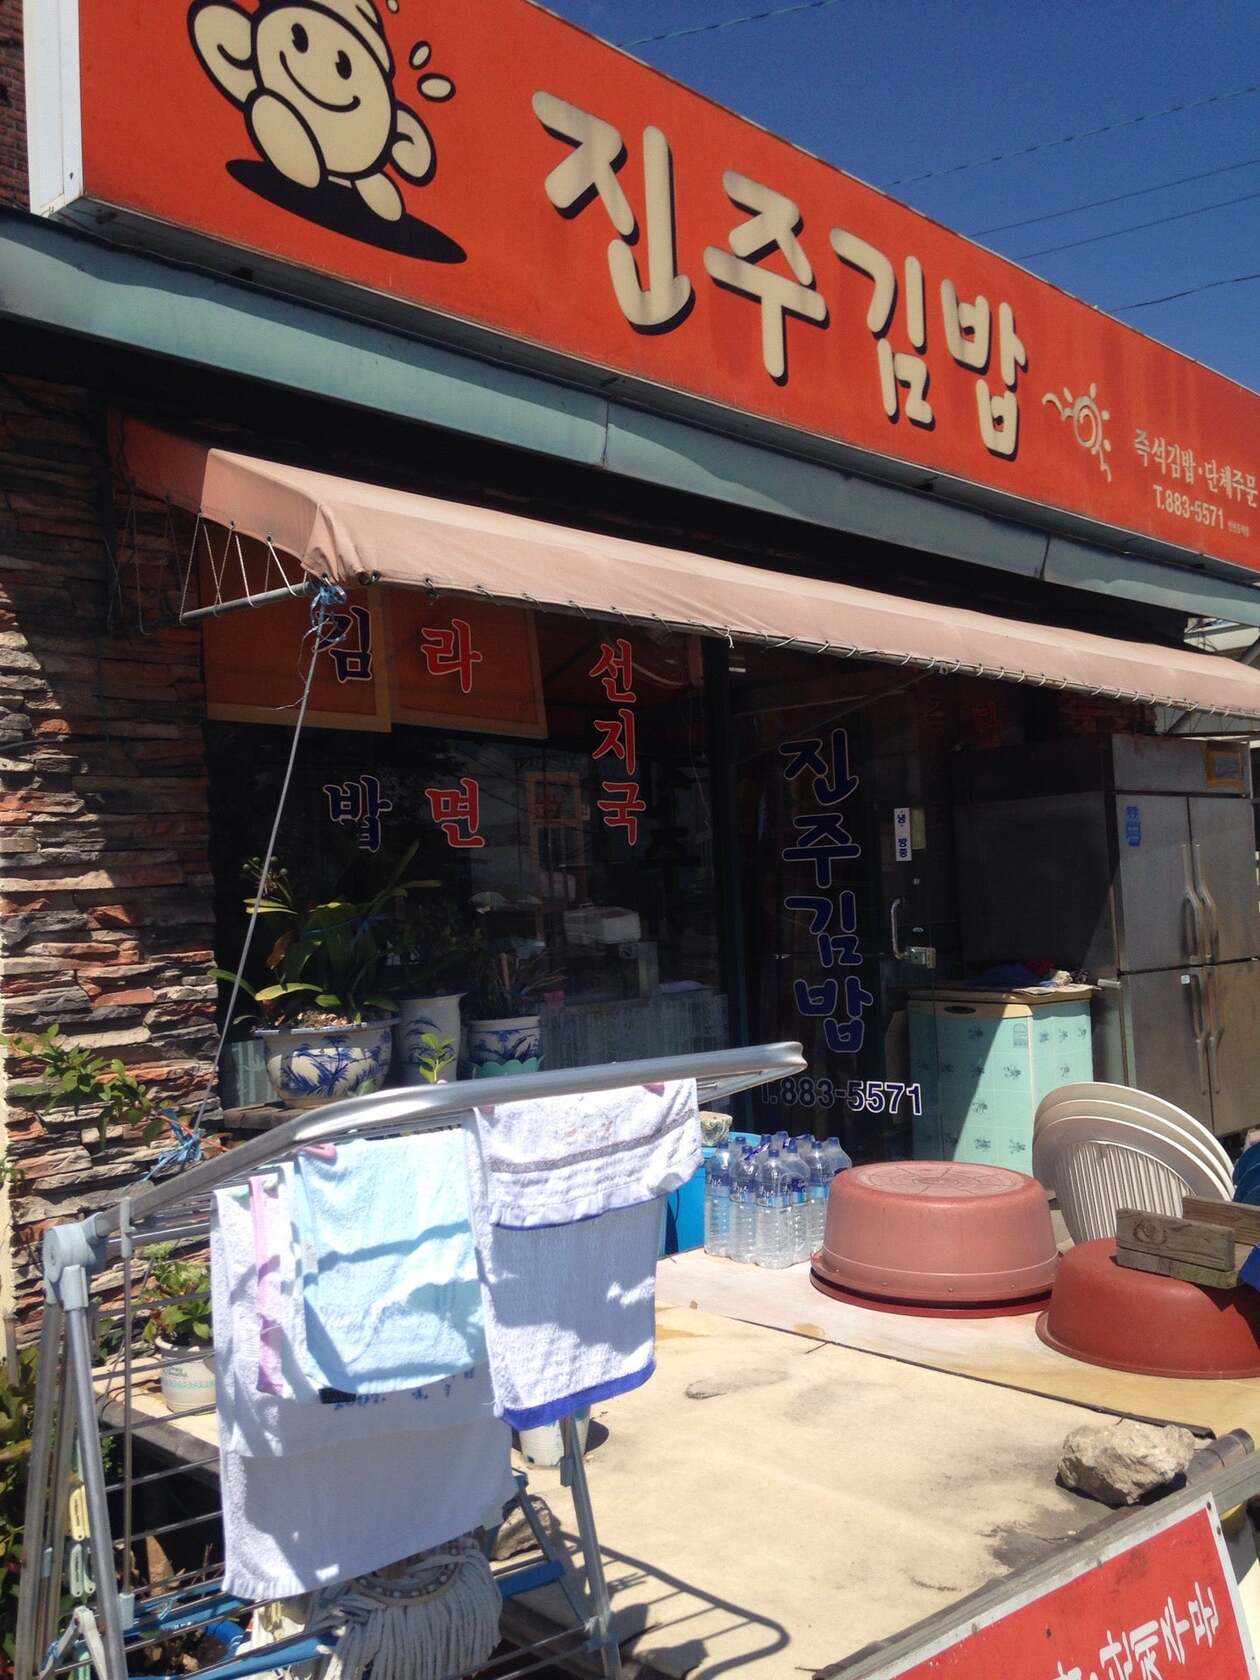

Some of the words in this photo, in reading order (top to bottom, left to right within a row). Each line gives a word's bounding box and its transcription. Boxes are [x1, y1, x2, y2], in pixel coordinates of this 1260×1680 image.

[532, 90, 1027, 460] 진주김밥
[588, 638, 647, 847] 선지국
[778, 728, 874, 1054] 진주김밥
